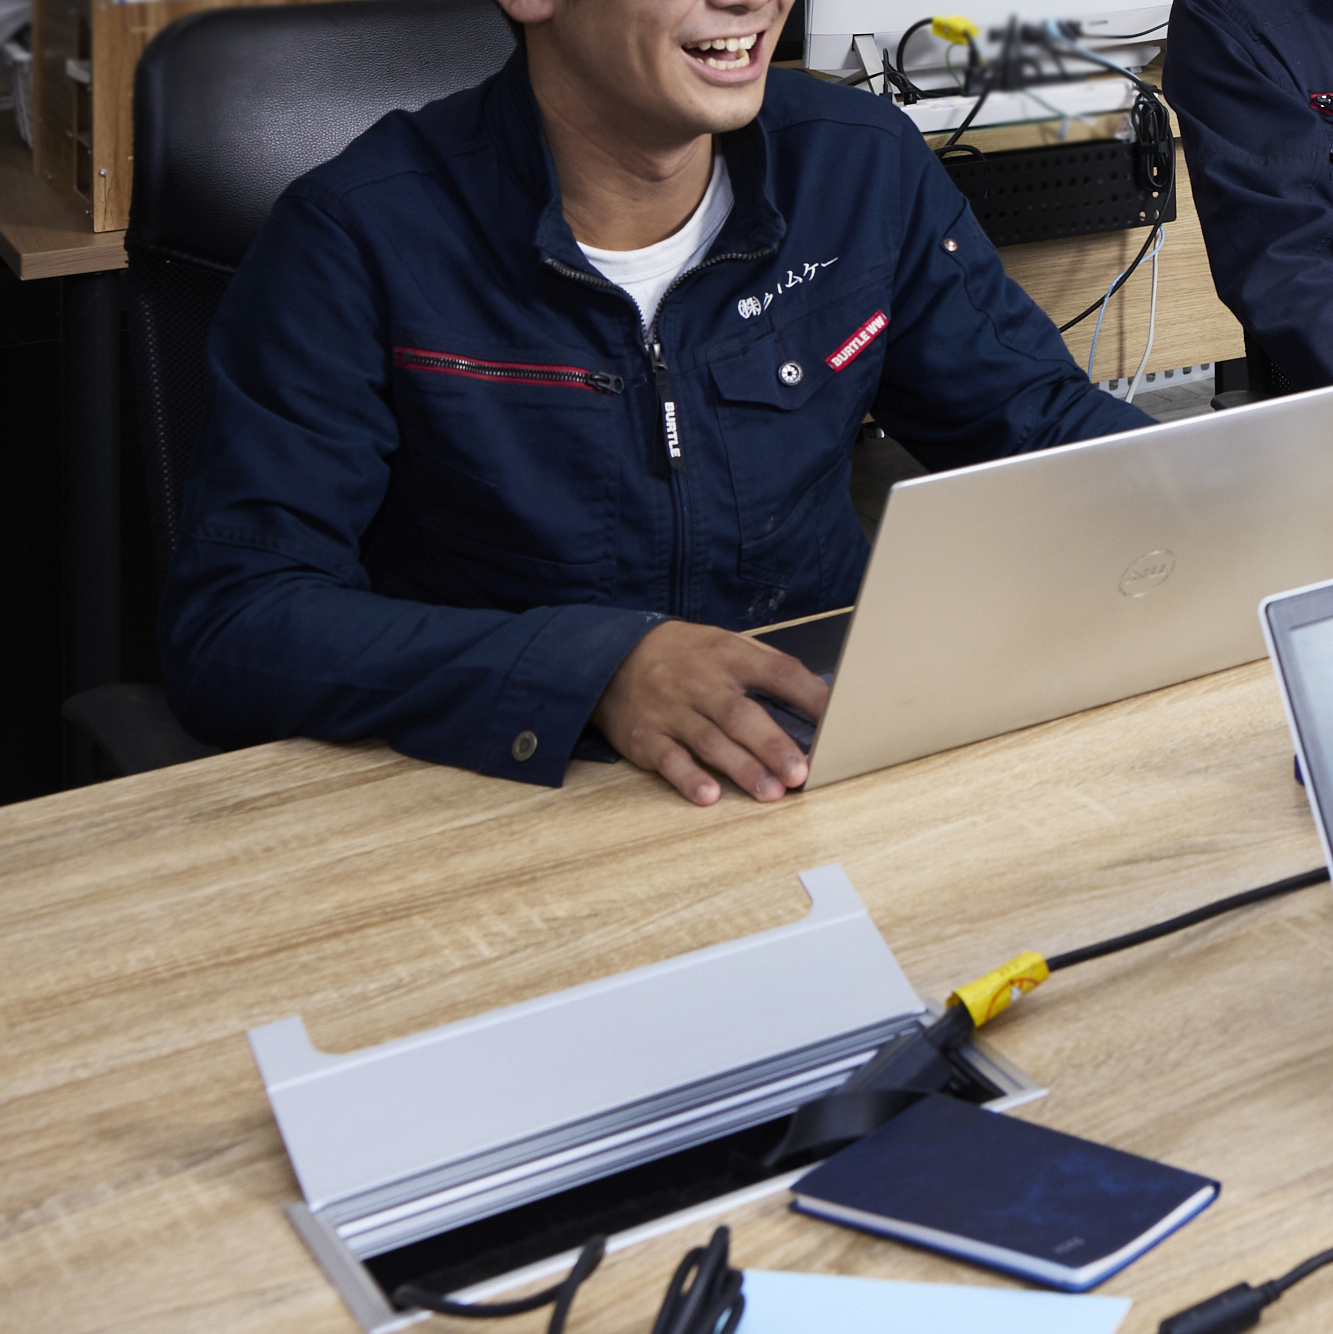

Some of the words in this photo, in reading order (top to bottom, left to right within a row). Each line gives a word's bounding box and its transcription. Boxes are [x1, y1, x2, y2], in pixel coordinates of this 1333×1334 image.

[831, 330, 871, 368] BURTLE
[866, 315, 885, 336] WW
[664, 401, 681, 458] BURTLE
